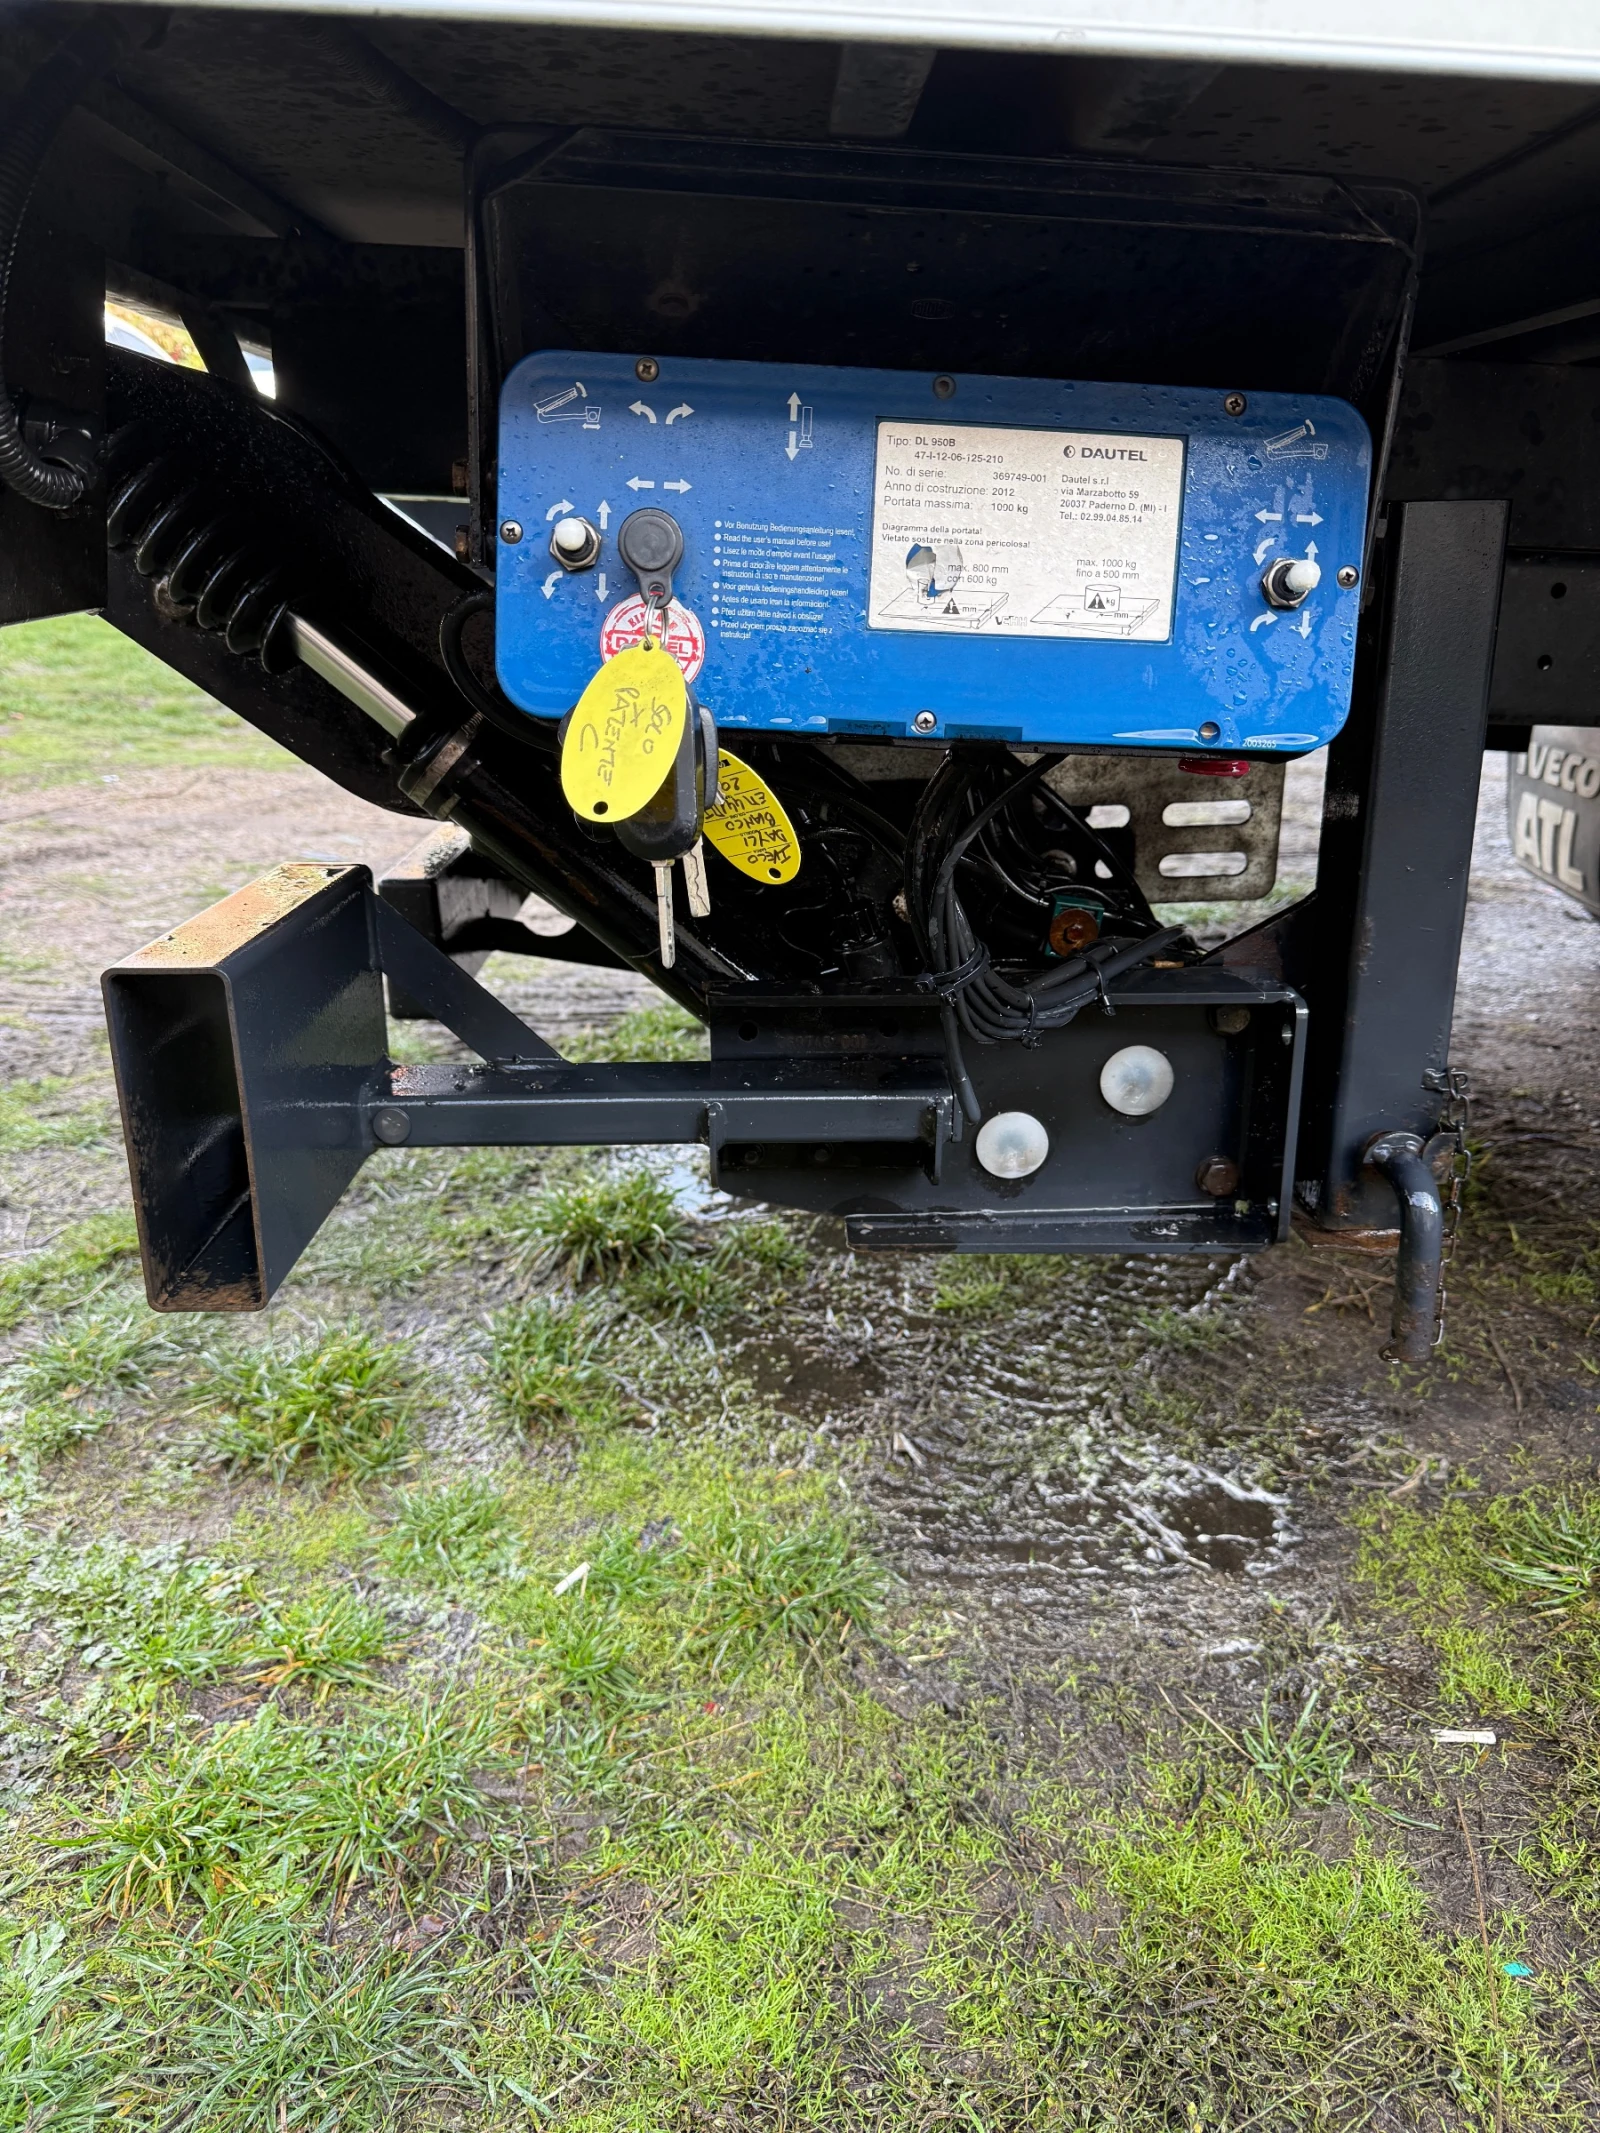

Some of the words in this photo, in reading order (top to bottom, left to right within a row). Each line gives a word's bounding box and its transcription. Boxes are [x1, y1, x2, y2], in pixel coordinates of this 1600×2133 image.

[886, 435, 912, 448] Tipo:
[915, 436, 928, 446] DL
[931, 438, 956, 447] 950B
[914, 451, 1004, 464] 47-I-12-06-125-210
[1081, 447, 1148, 461] DAUTEL
[885, 466, 902, 476] No.
[906, 466, 916, 476] di
[919, 468, 947, 478] serie:
[992, 472, 1047, 483] 369749-001
[1062, 474, 1090, 484] Dautel
[884, 481, 912, 492] Anno
[914, 482, 924, 492] di
[926, 484, 989, 496] costruzione:
[992, 488, 1015, 497] 2012
[1060, 488, 1074, 496] via
[1076, 488, 1126, 499] Marzabotto
[1128, 490, 1140, 499] 59
[884, 496, 920, 508] Portata
[924, 500, 973, 510] massima:
[991, 502, 1014, 512] 1000
[1016, 504, 1028, 515] kg
[1060, 499, 1086, 508] 20037
[1088, 500, 1126, 511] Paderno
[1128, 503, 1138, 512] D.
[1140, 504, 1156, 514] (MI)
[1060, 512, 1078, 521] Tel.:
[1080, 512, 1143, 524] 02.99.04.85.14
[724, 520, 735, 528] Vor
[736, 521, 768, 532] Benutzung
[882, 522, 928, 533] Diagramma
[930, 525, 950, 534] della
[952, 526, 982, 536] portata!
[723, 534, 740, 542] Read
[742, 534, 752, 542] the
[753, 536, 772, 544] user's
[772, 537, 796, 546] manual
[796, 538, 816, 546] before
[818, 540, 831, 548] use!
[882, 534, 910, 542] Vietato
[912, 536, 942, 544] sostare
[944, 536, 962, 545] nella
[986, 540, 1030, 548] pericolosa!
[722, 547, 739, 556] Lisez
[741, 548, 747, 556] le
[748, 548, 765, 556] mode
[766, 549, 792, 559] d'emploi
[793, 551, 811, 560] avant
[722, 559, 741, 568] Prima
[742, 560, 748, 568] di
[776, 562, 800, 572] leggere
[800, 564, 842, 573] attentamente
[842, 566, 848, 574] le
[948, 564, 970, 573] max.
[972, 564, 990, 573] 800
[992, 566, 1009, 574] mm
[1076, 559, 1098, 567] max.
[1102, 558, 1124, 568] 1000
[1125, 559, 1136, 570] kg
[966, 575, 984, 584] 600
[986, 576, 998, 586] kg
[1076, 568, 1092, 578] fino
[1103, 570, 1120, 579] 500
[1122, 572, 1140, 580] mm
[722, 582, 736, 590] Voor
[738, 583, 760, 592] gebruik
[830, 588, 848, 596] lezen!
[740, 596, 749, 604] de
[1106, 597, 1116, 606] kg
[720, 620, 739, 629] Przed
[580, 723, 599, 752] C
[1516, 741, 1600, 799] IVECO
[724, 812, 776, 832] BIANCO
[1515, 791, 1584, 892] ATL
[747, 844, 792, 864] IVECO
